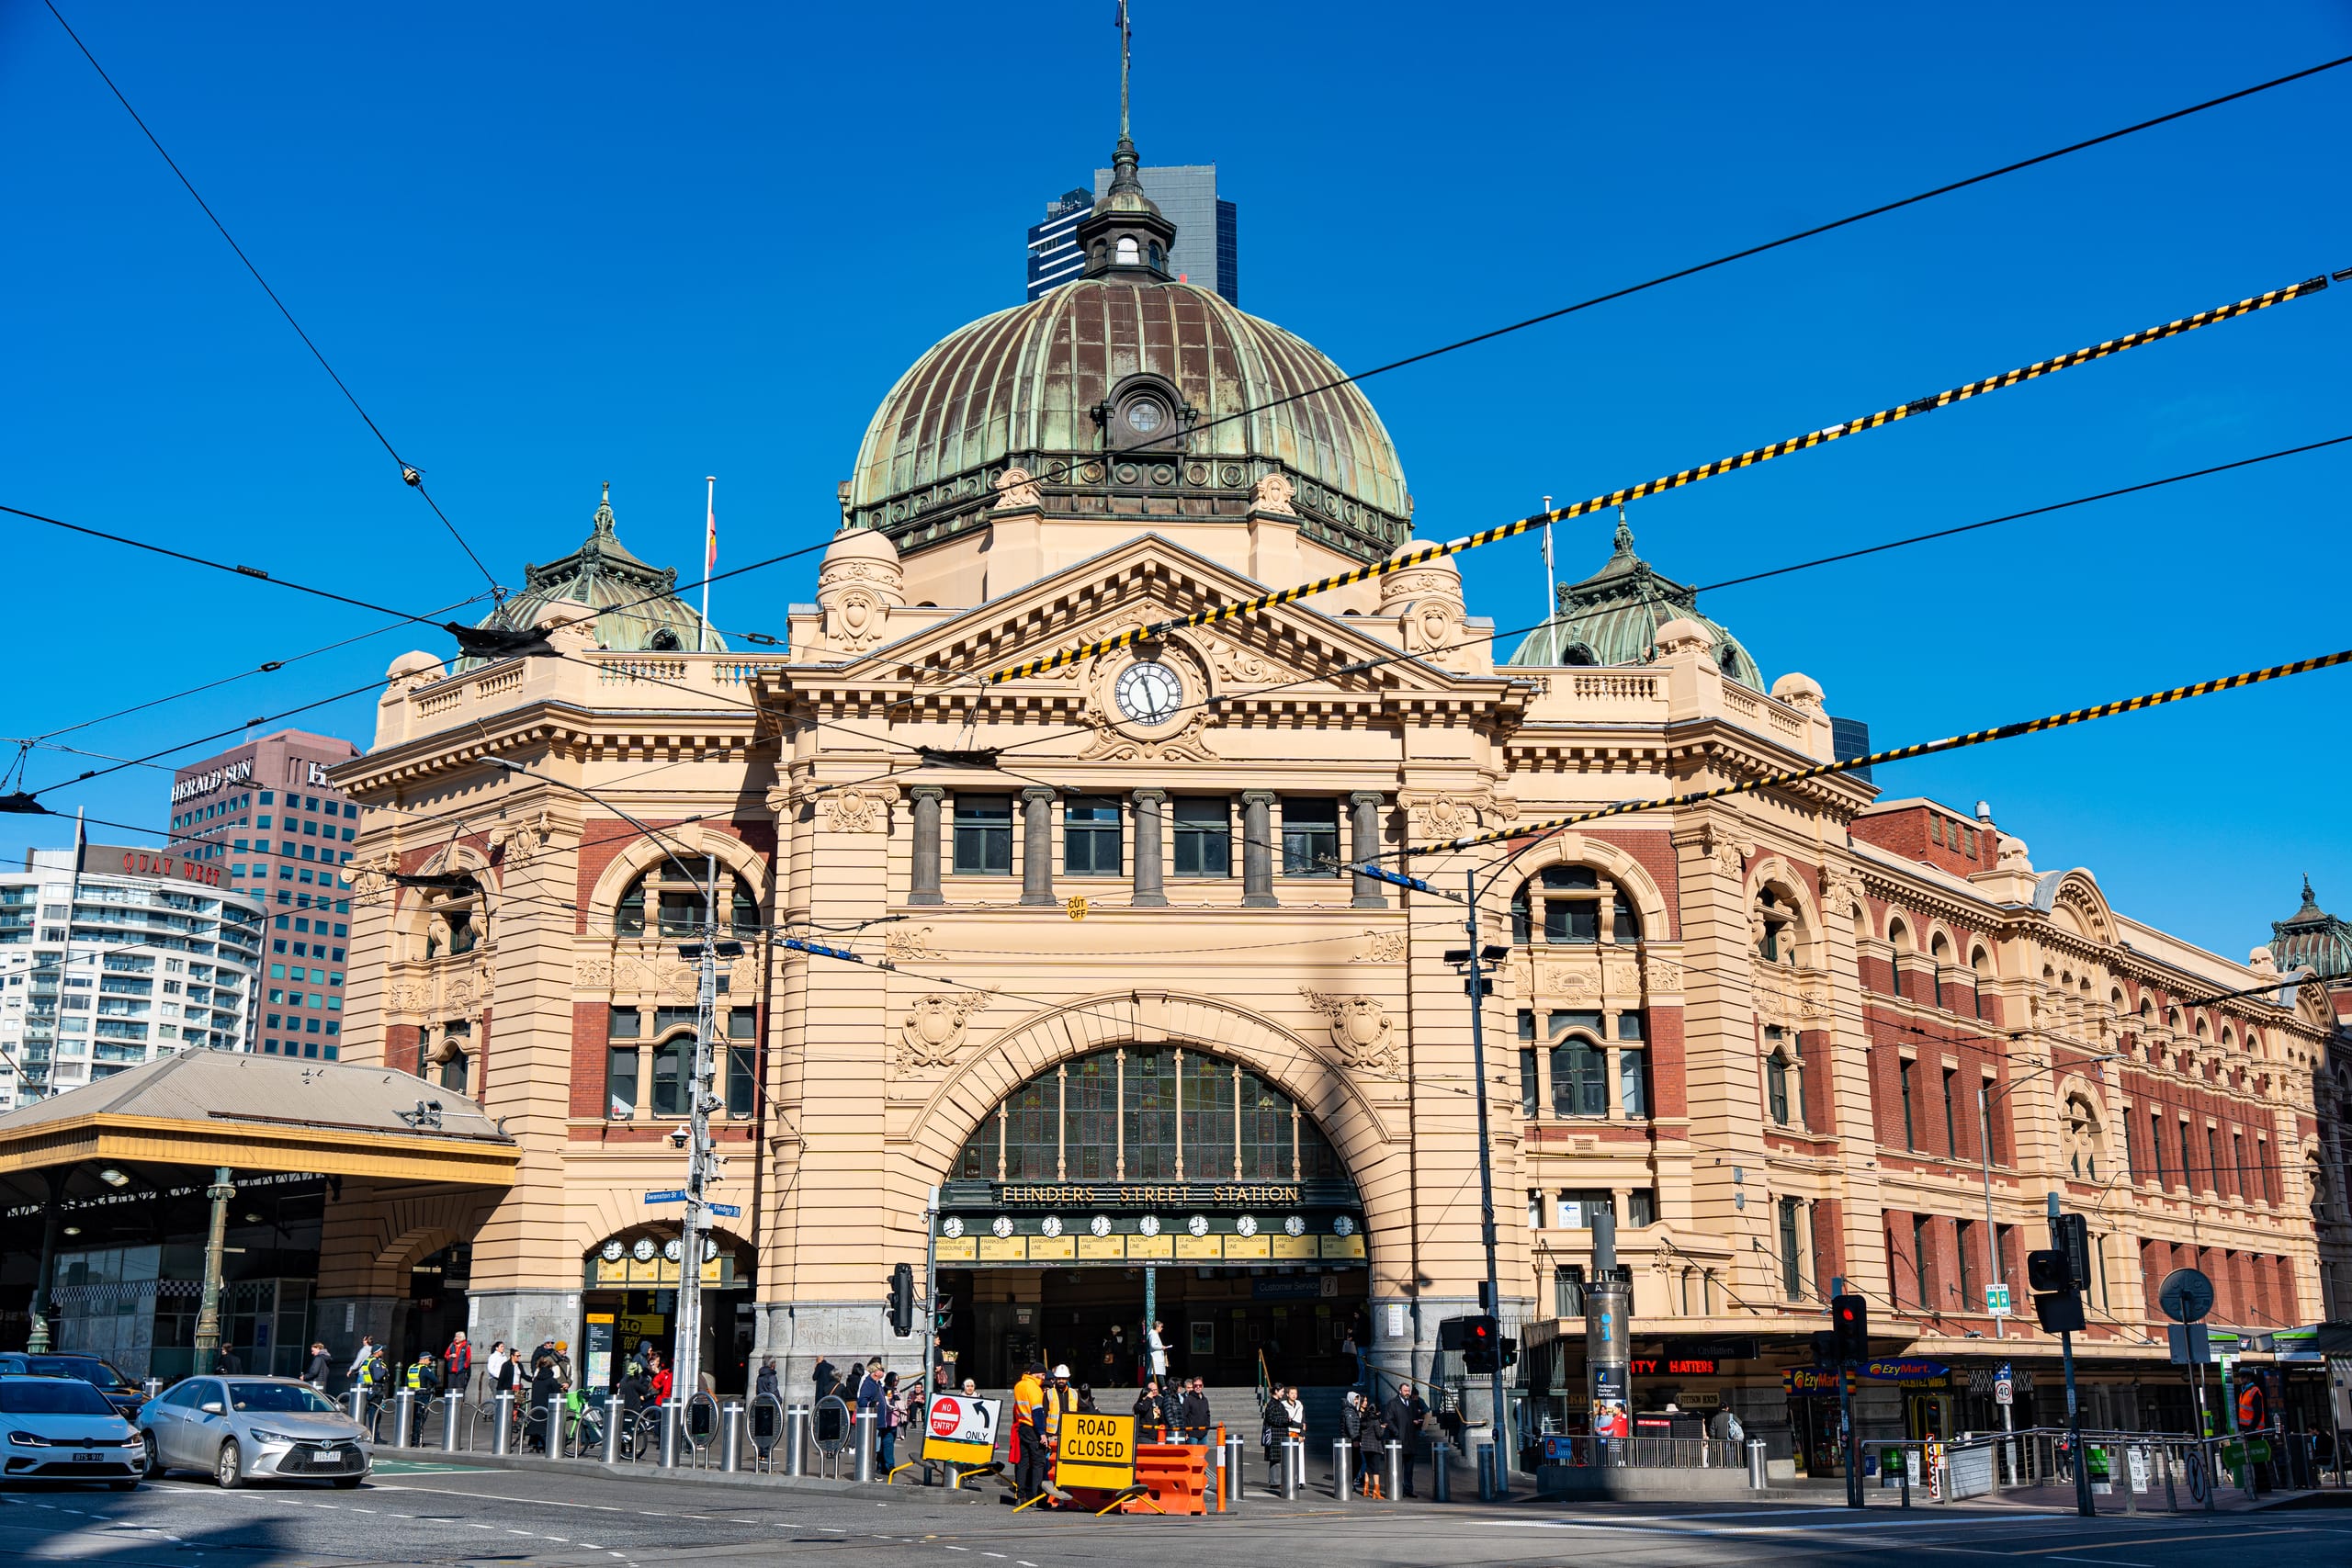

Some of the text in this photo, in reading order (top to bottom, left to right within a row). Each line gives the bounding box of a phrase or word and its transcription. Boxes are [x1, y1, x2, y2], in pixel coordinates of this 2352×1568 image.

[171, 760, 254, 803] HERALD SUN
[123, 852, 220, 886] QUAY WEST
[1069, 898, 1085, 908] CUT
[1069, 909, 1086, 919] OFF
[646, 1191, 671, 1201] Swanston
[1002, 1186, 1298, 1201] FLINDERS STREET STATION
[714, 1204, 733, 1213] Flinders
[1259, 1282, 1293, 1292] Customer
[1294, 1281, 1319, 1290] Service
[1698, 1346, 1735, 1356] CityHatters
[1631, 1360, 1714, 1373] ITY HATTERS
[1882, 1363, 1929, 1376] EzyMart
[1804, 1371, 1840, 1391] EzyMart
[1998, 1387, 2009, 1397] 40
[942, 1403, 952, 1412] NO
[933, 1420, 956, 1431] ENTRY
[1077, 1419, 1116, 1437] ROAD
[966, 1430, 989, 1441] ONLY
[1068, 1439, 1124, 1458] CLOSED
